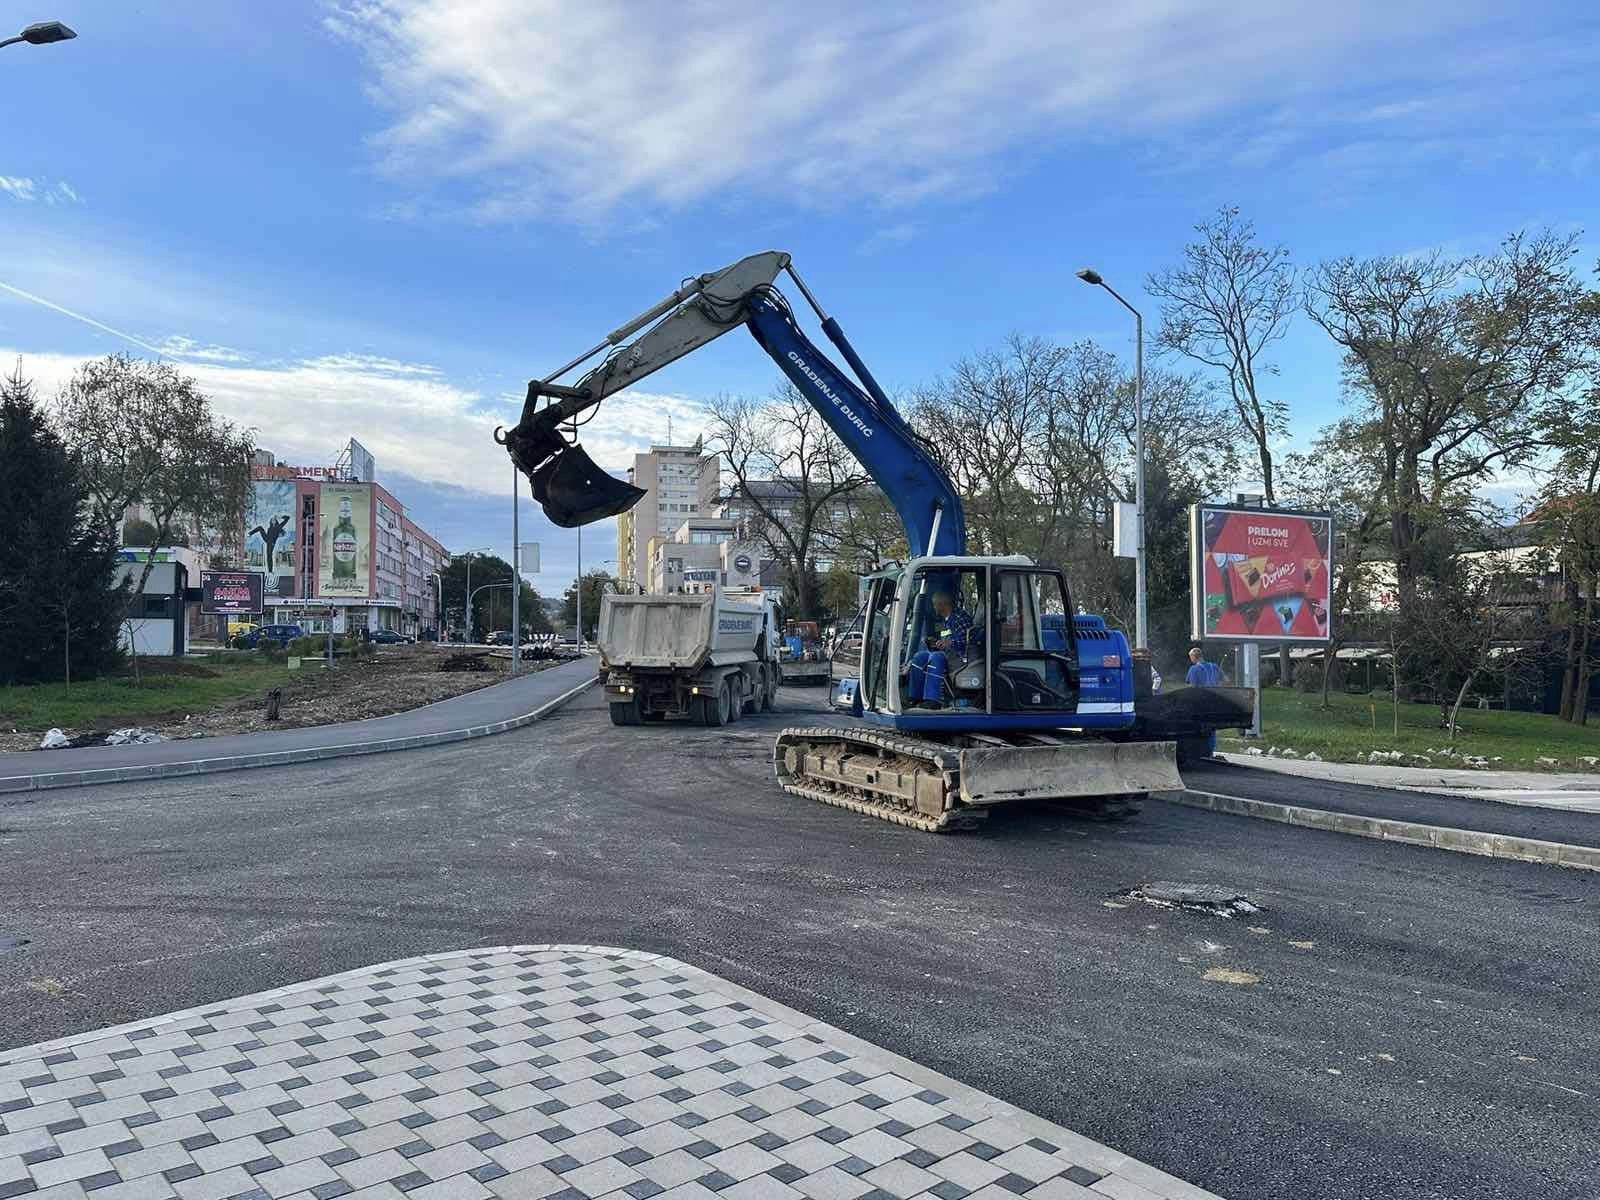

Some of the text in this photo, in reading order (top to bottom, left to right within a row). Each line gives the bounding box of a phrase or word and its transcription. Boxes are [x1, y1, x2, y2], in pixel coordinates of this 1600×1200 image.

[1247, 526, 1289, 538] PRELOMI
[1252, 537, 1272, 547] UZMI
[1273, 538, 1289, 548] SVE
